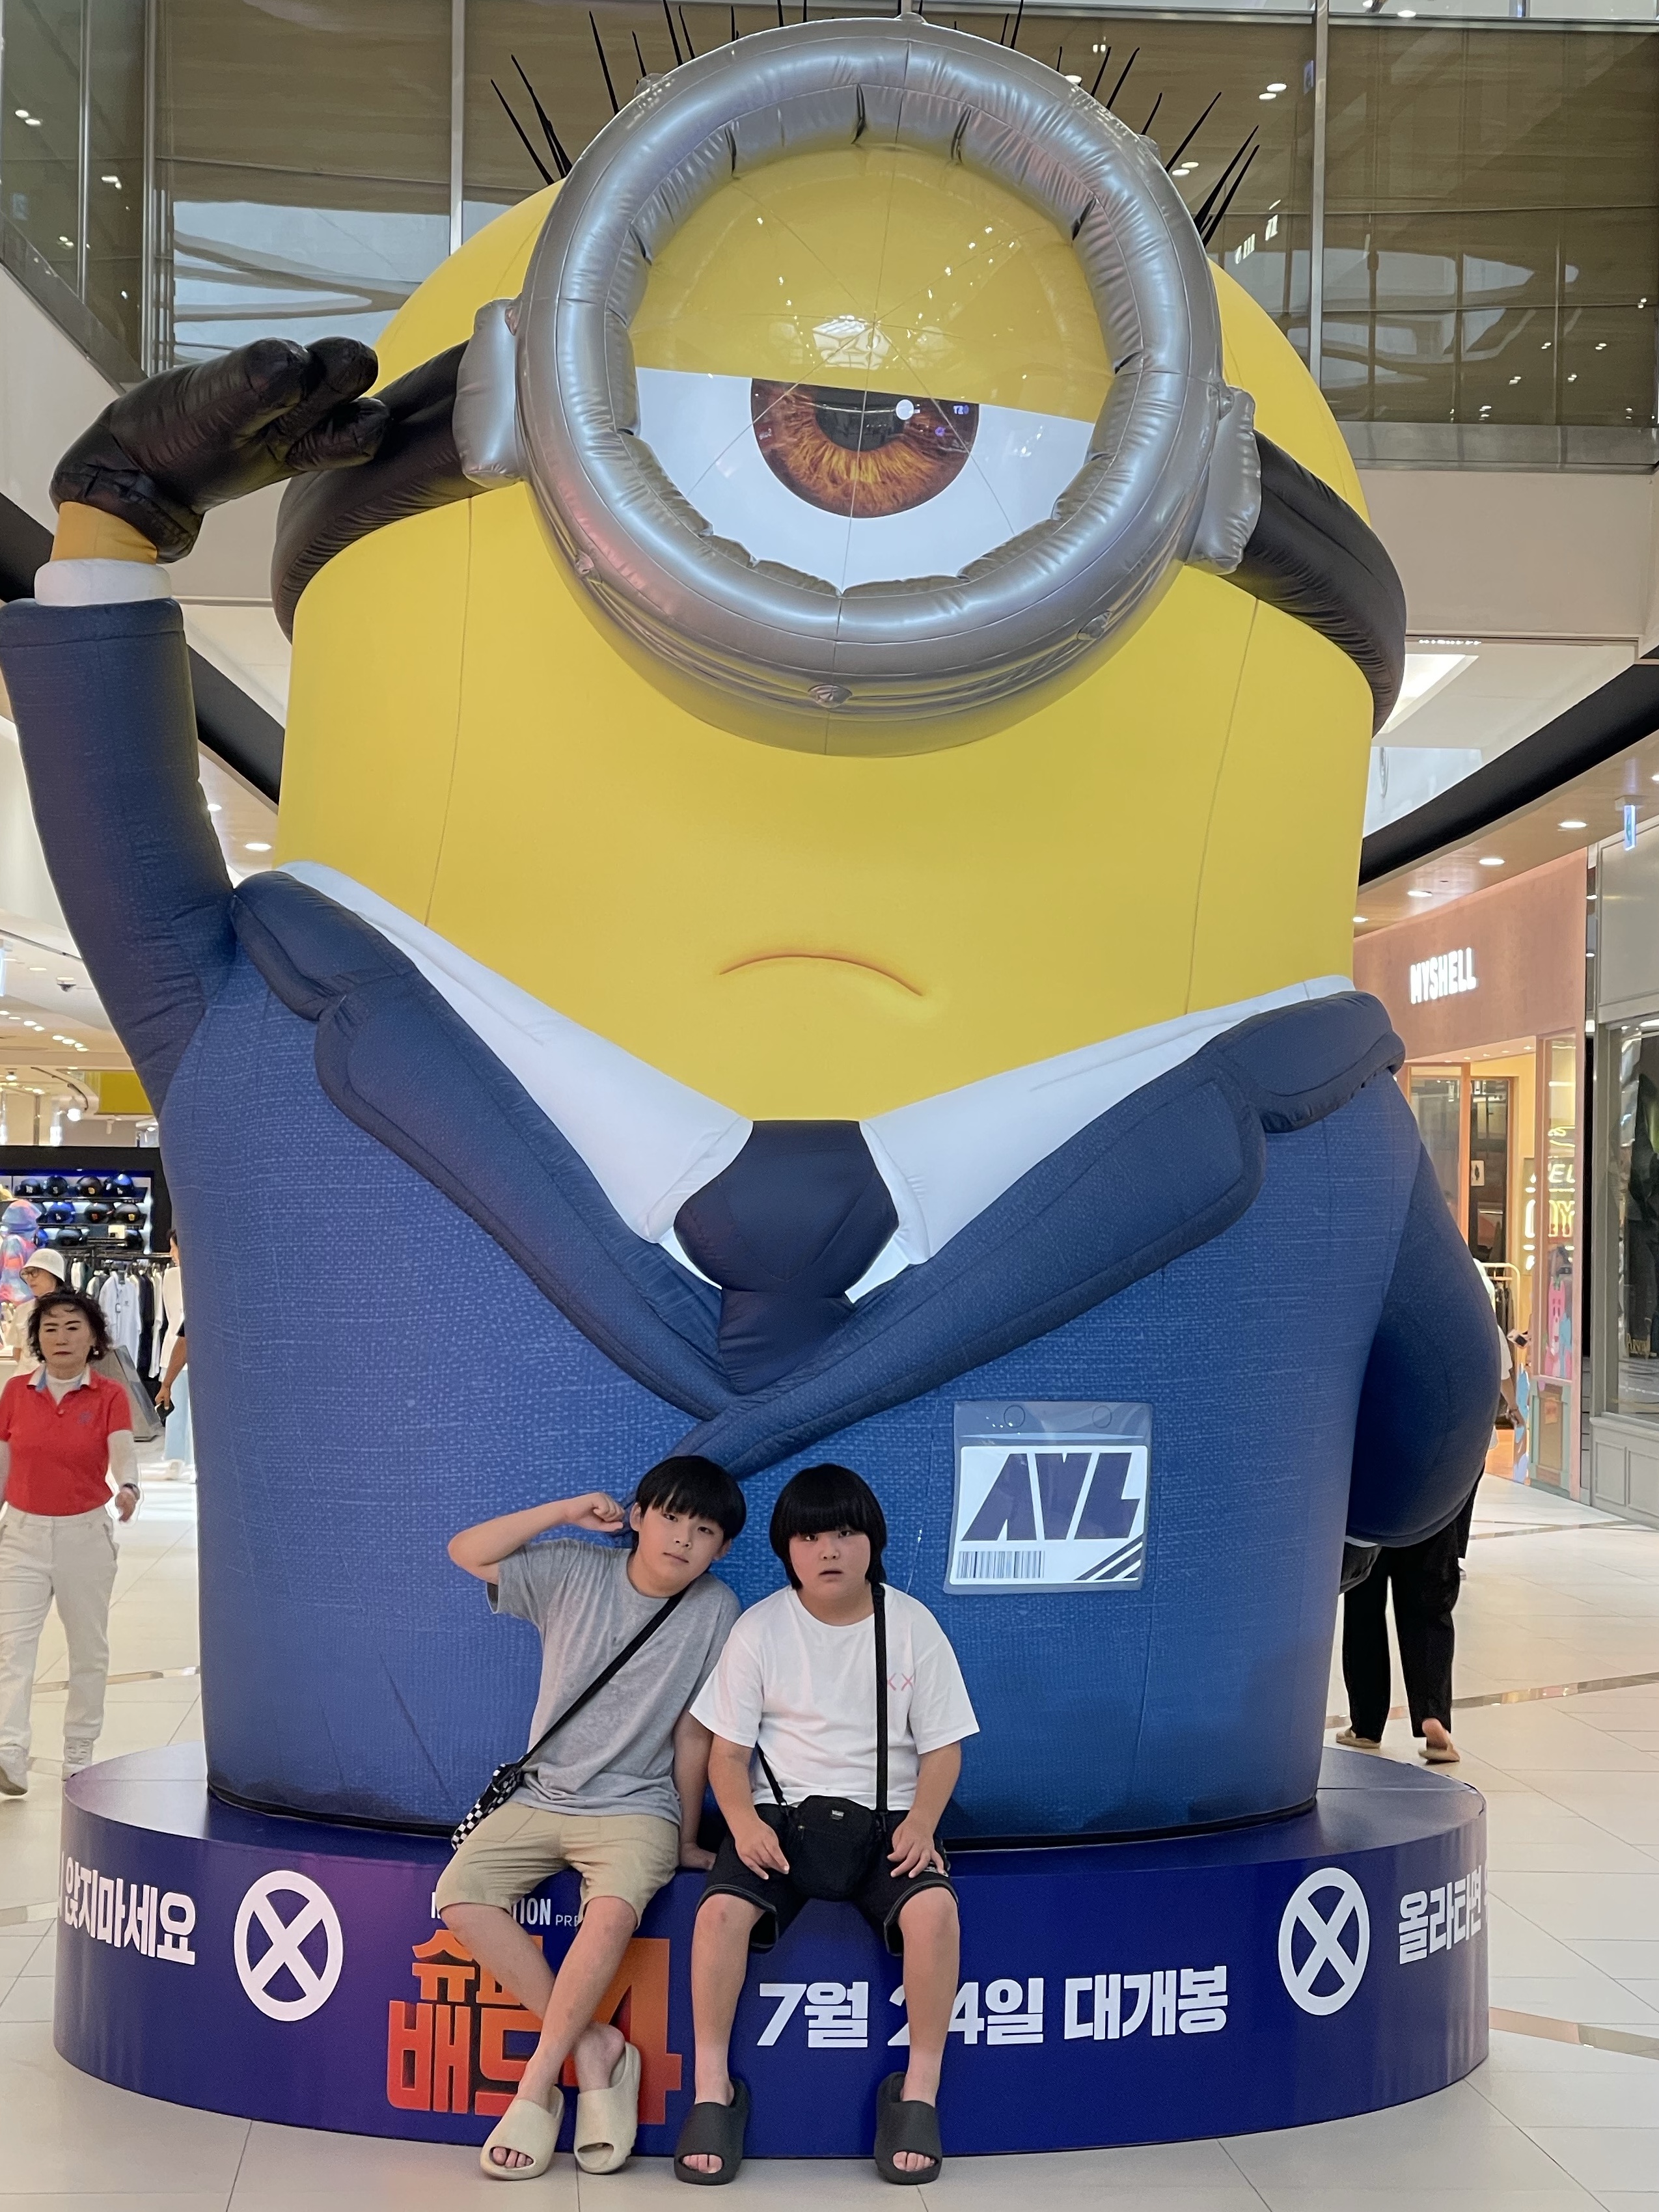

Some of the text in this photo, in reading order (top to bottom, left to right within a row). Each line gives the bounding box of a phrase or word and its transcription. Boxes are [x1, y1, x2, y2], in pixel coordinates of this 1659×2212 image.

[1410, 947, 1477, 1005] MYSHELL
[961, 1453, 1141, 1541] AVL
[64, 1857, 196, 1965] 앉지마세요
[1399, 1864, 1482, 1964] 올라타면
[756, 1982, 869, 2048] 7월
[1064, 1965, 1229, 2041] 대개봉
